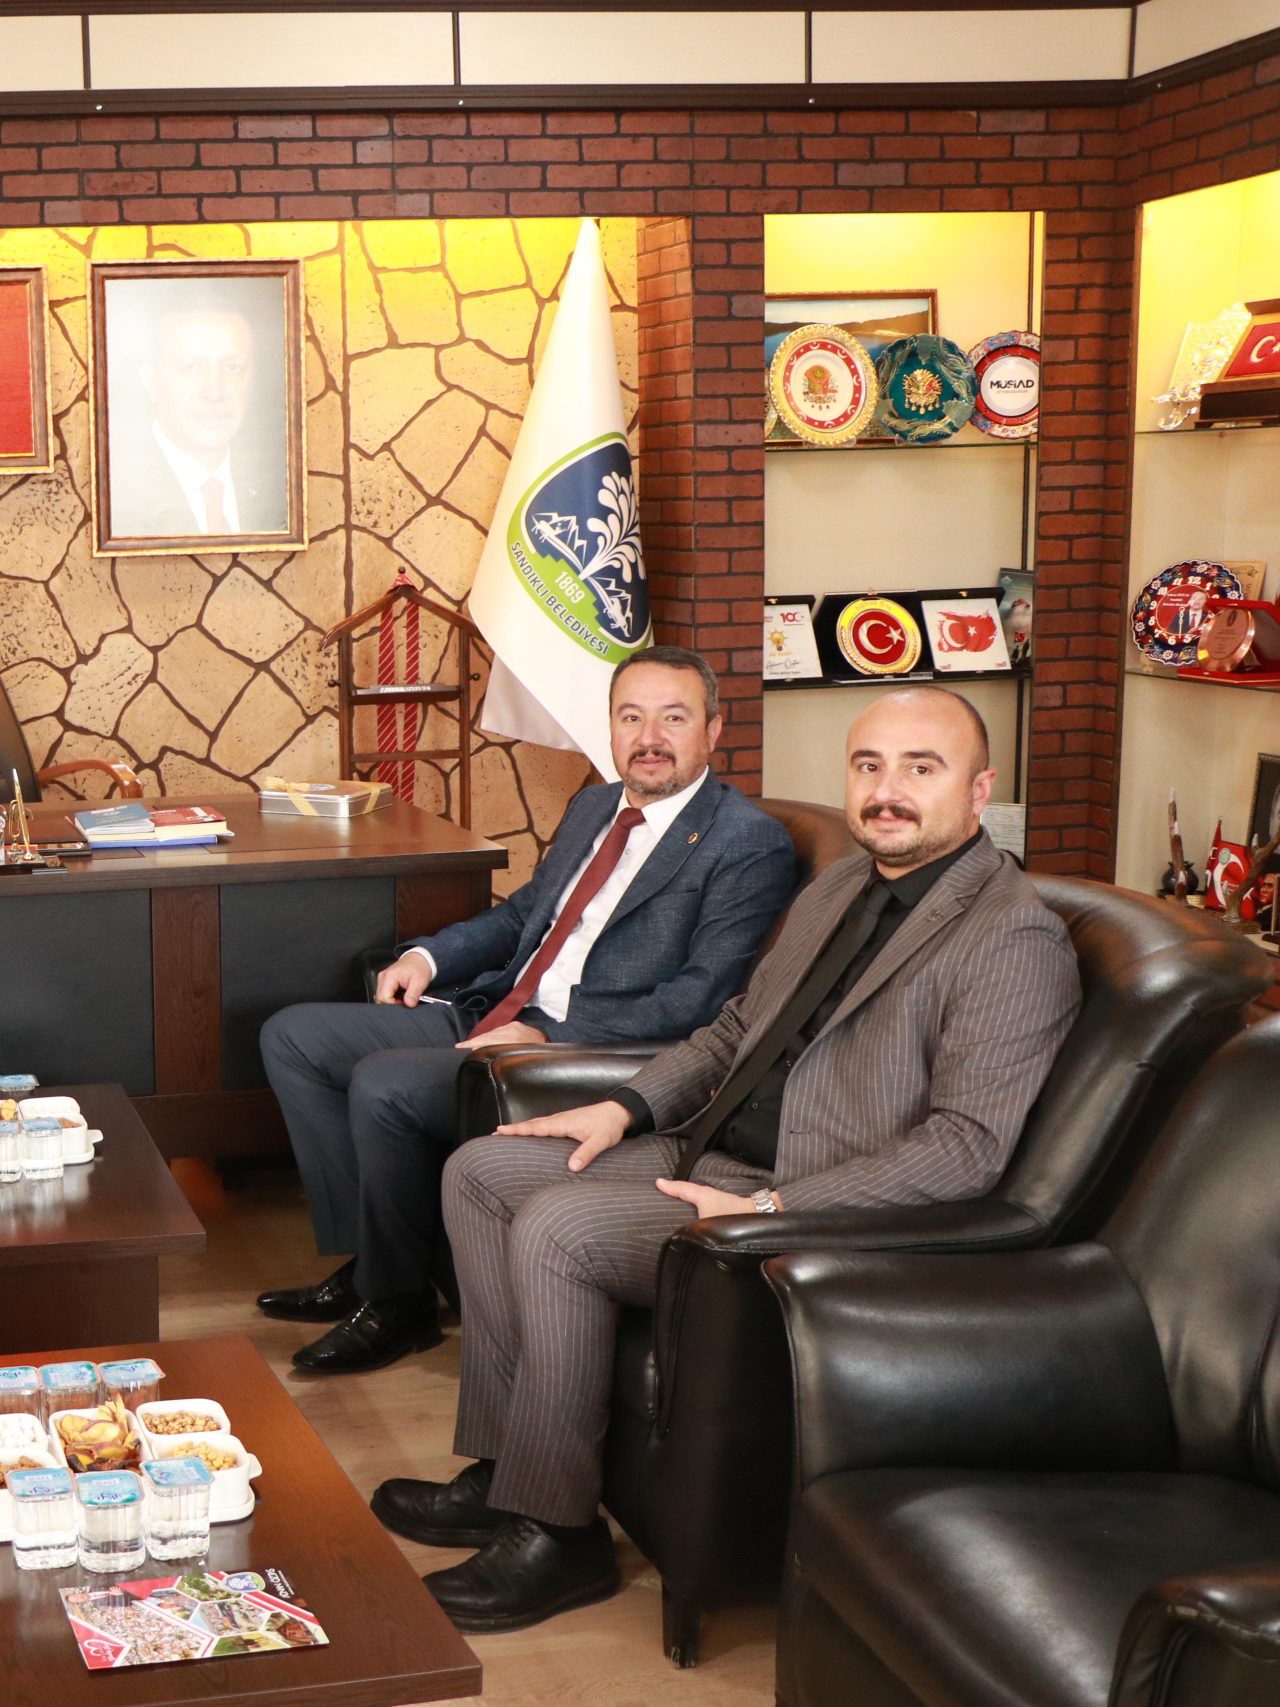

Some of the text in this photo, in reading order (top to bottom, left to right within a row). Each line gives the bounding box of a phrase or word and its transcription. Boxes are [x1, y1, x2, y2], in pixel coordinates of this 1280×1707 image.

[511, 541, 610, 656] SANDIKLI BELEDİYESİ
[553, 570, 586, 605] 1869
